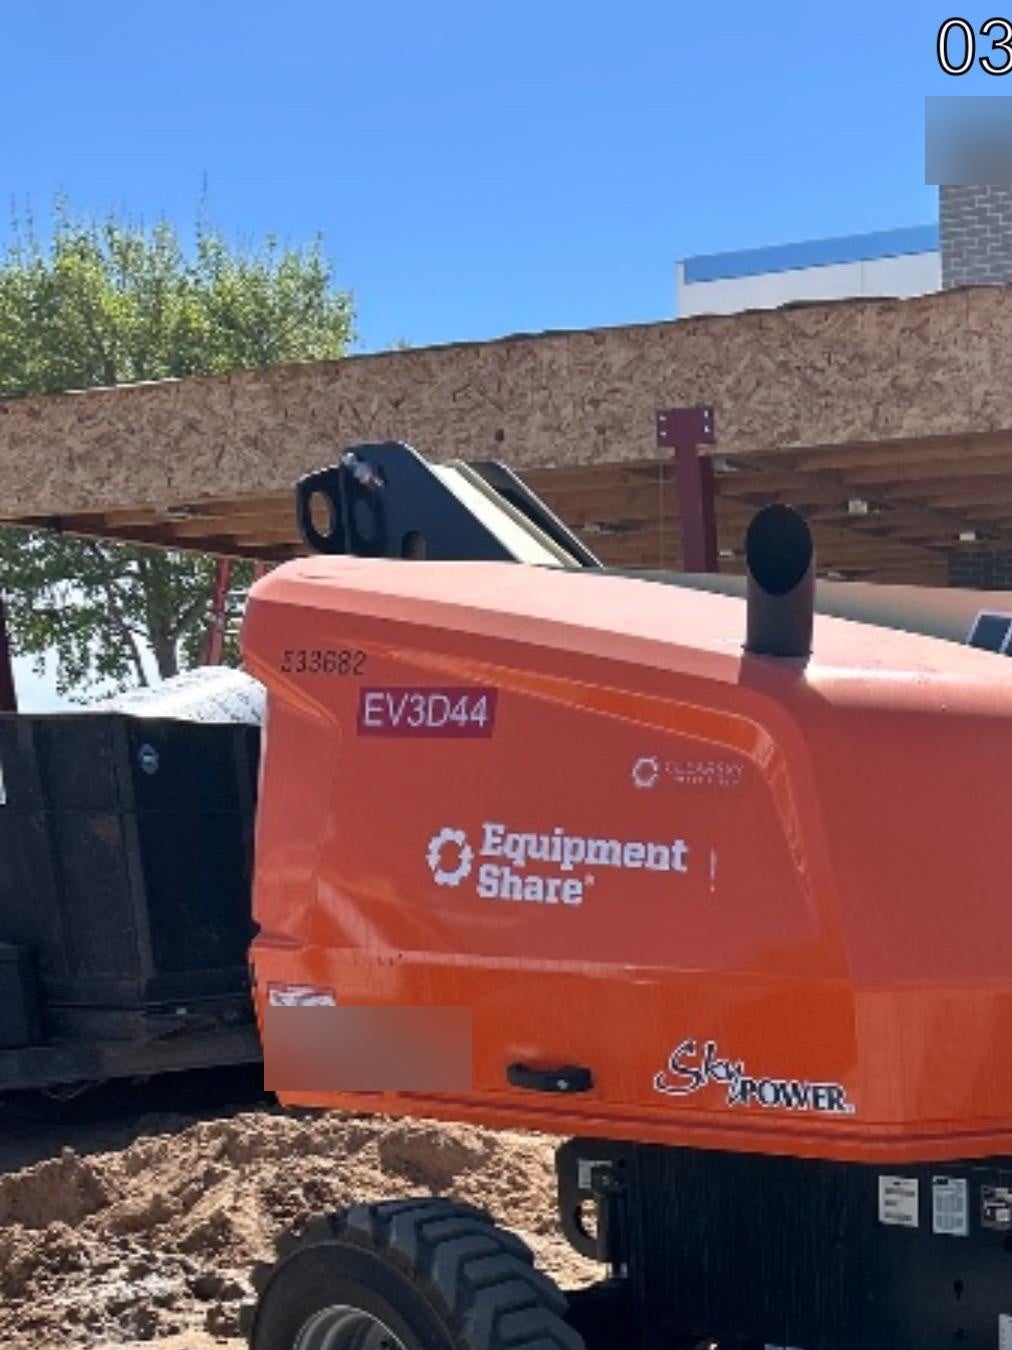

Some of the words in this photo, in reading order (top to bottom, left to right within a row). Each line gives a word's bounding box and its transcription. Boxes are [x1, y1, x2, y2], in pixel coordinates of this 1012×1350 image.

[281, 650, 367, 676] 533682
[363, 691, 489, 728] EV3D44
[479, 822, 689, 873] Equipment
